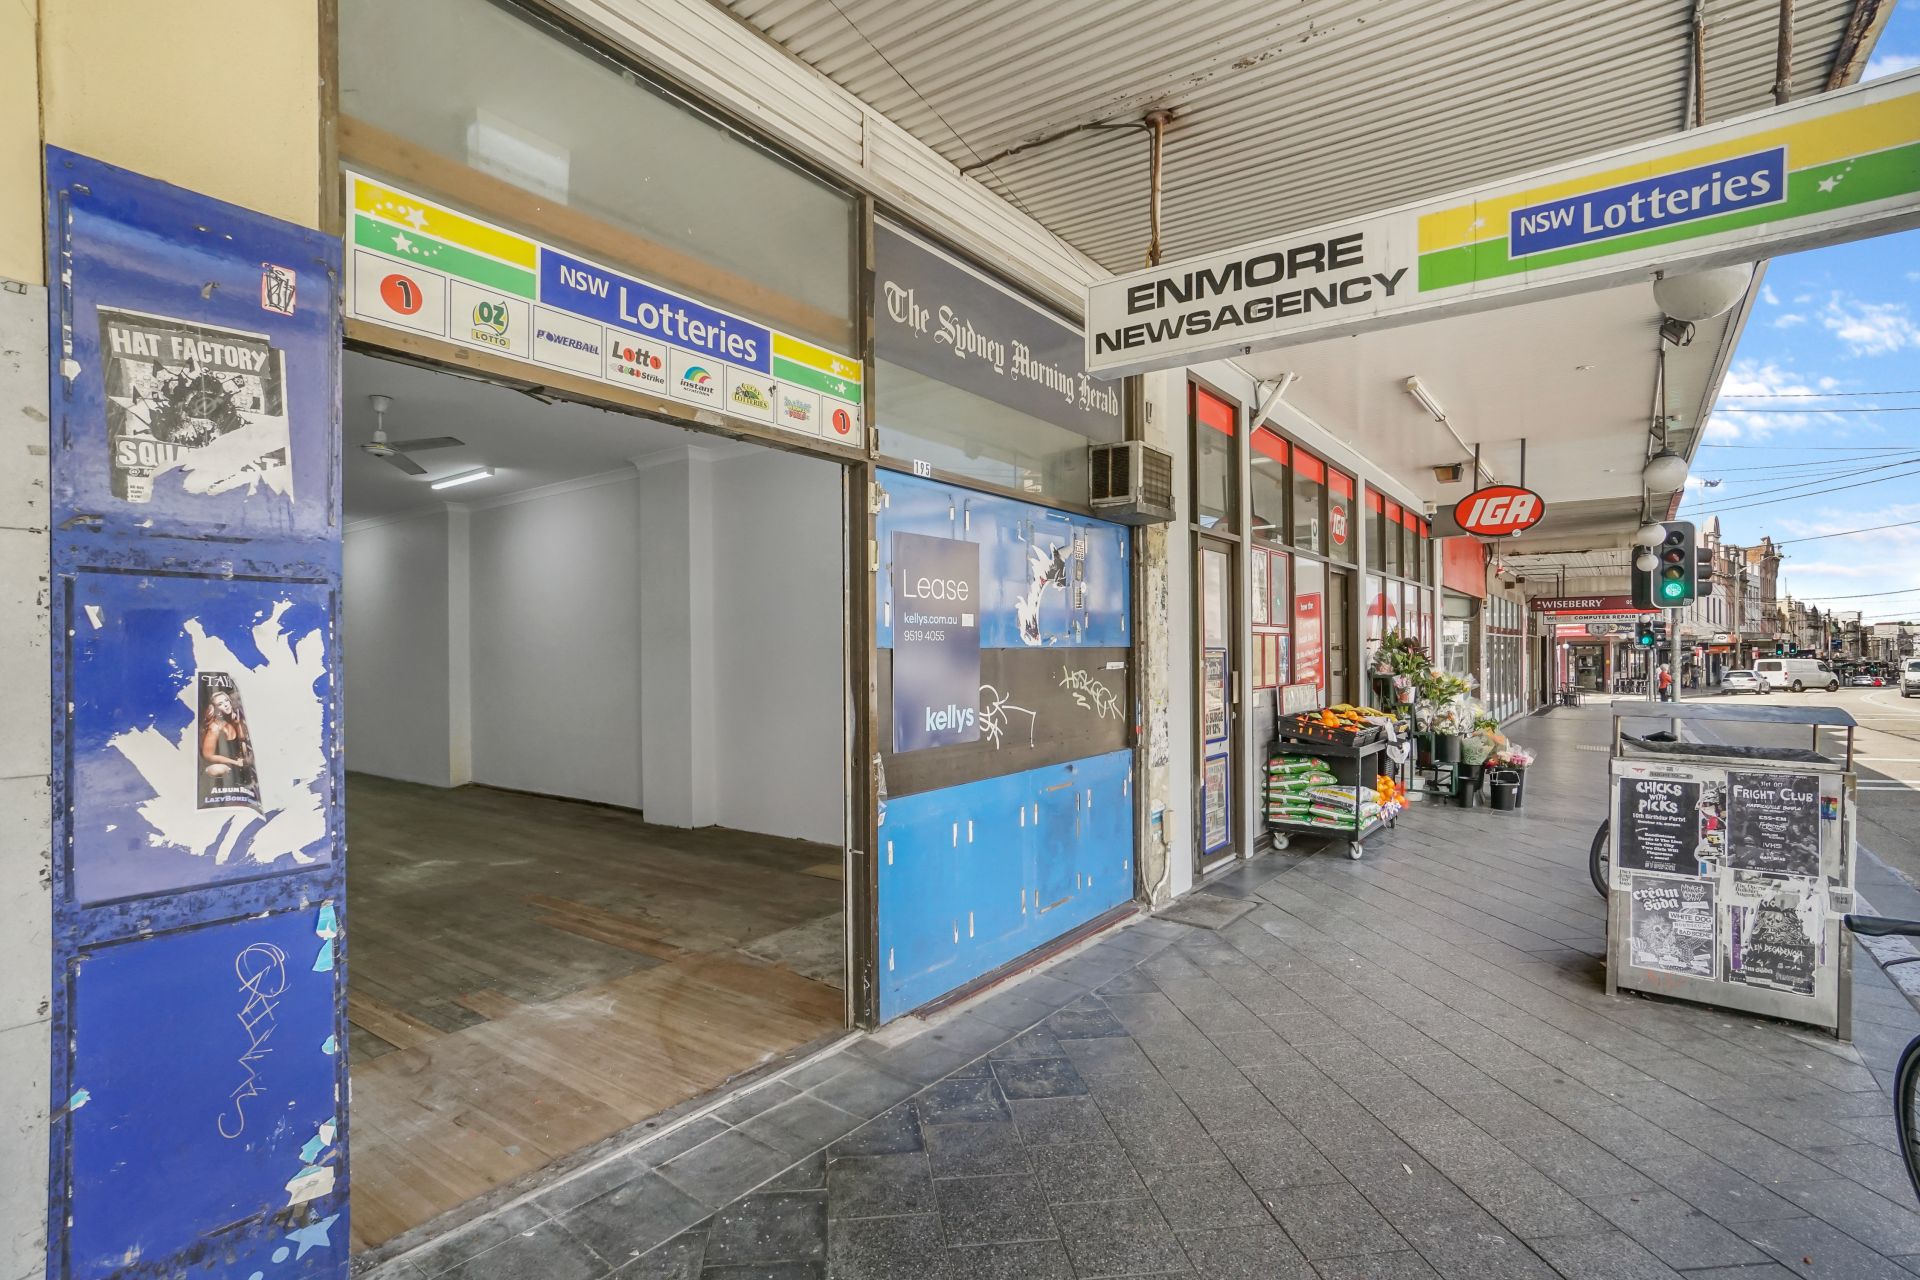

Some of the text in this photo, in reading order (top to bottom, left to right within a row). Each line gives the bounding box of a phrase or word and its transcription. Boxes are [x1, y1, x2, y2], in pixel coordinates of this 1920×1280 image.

[1519, 168, 1771, 236] NSW Lotteries
[1127, 232, 1364, 315] ENMORE
[478, 301, 505, 326] OZ
[560, 264, 757, 362] NSW Lotteries
[1095, 267, 1409, 355] NEWSAGENCY
[109, 327, 267, 372] HAT FACTORY
[474, 332, 507, 347] LOTTO
[536, 329, 600, 355] POWERBALL
[884, 280, 1119, 417] The Sydney Morning Herald
[612, 341, 662, 370] Lotto
[641, 372, 665, 385] Strike
[680, 378, 714, 394] instant
[914, 461, 930, 476] 195
[1465, 494, 1537, 528] IGA
[903, 569, 969, 601] Lease
[1542, 599, 1603, 609] WISEBERRY
[903, 612, 958, 626] kellys.com.au
[903, 630, 945, 642] 9519 4055
[925, 704, 975, 733] kellys
[1635, 781, 1682, 796] CHICKS
[1649, 793, 1667, 801] WITH
[1733, 785, 1813, 802] FRIGHT CLUB
[1638, 799, 1678, 813] PICKS
[1669, 912, 1712, 924] WHITE DOG
